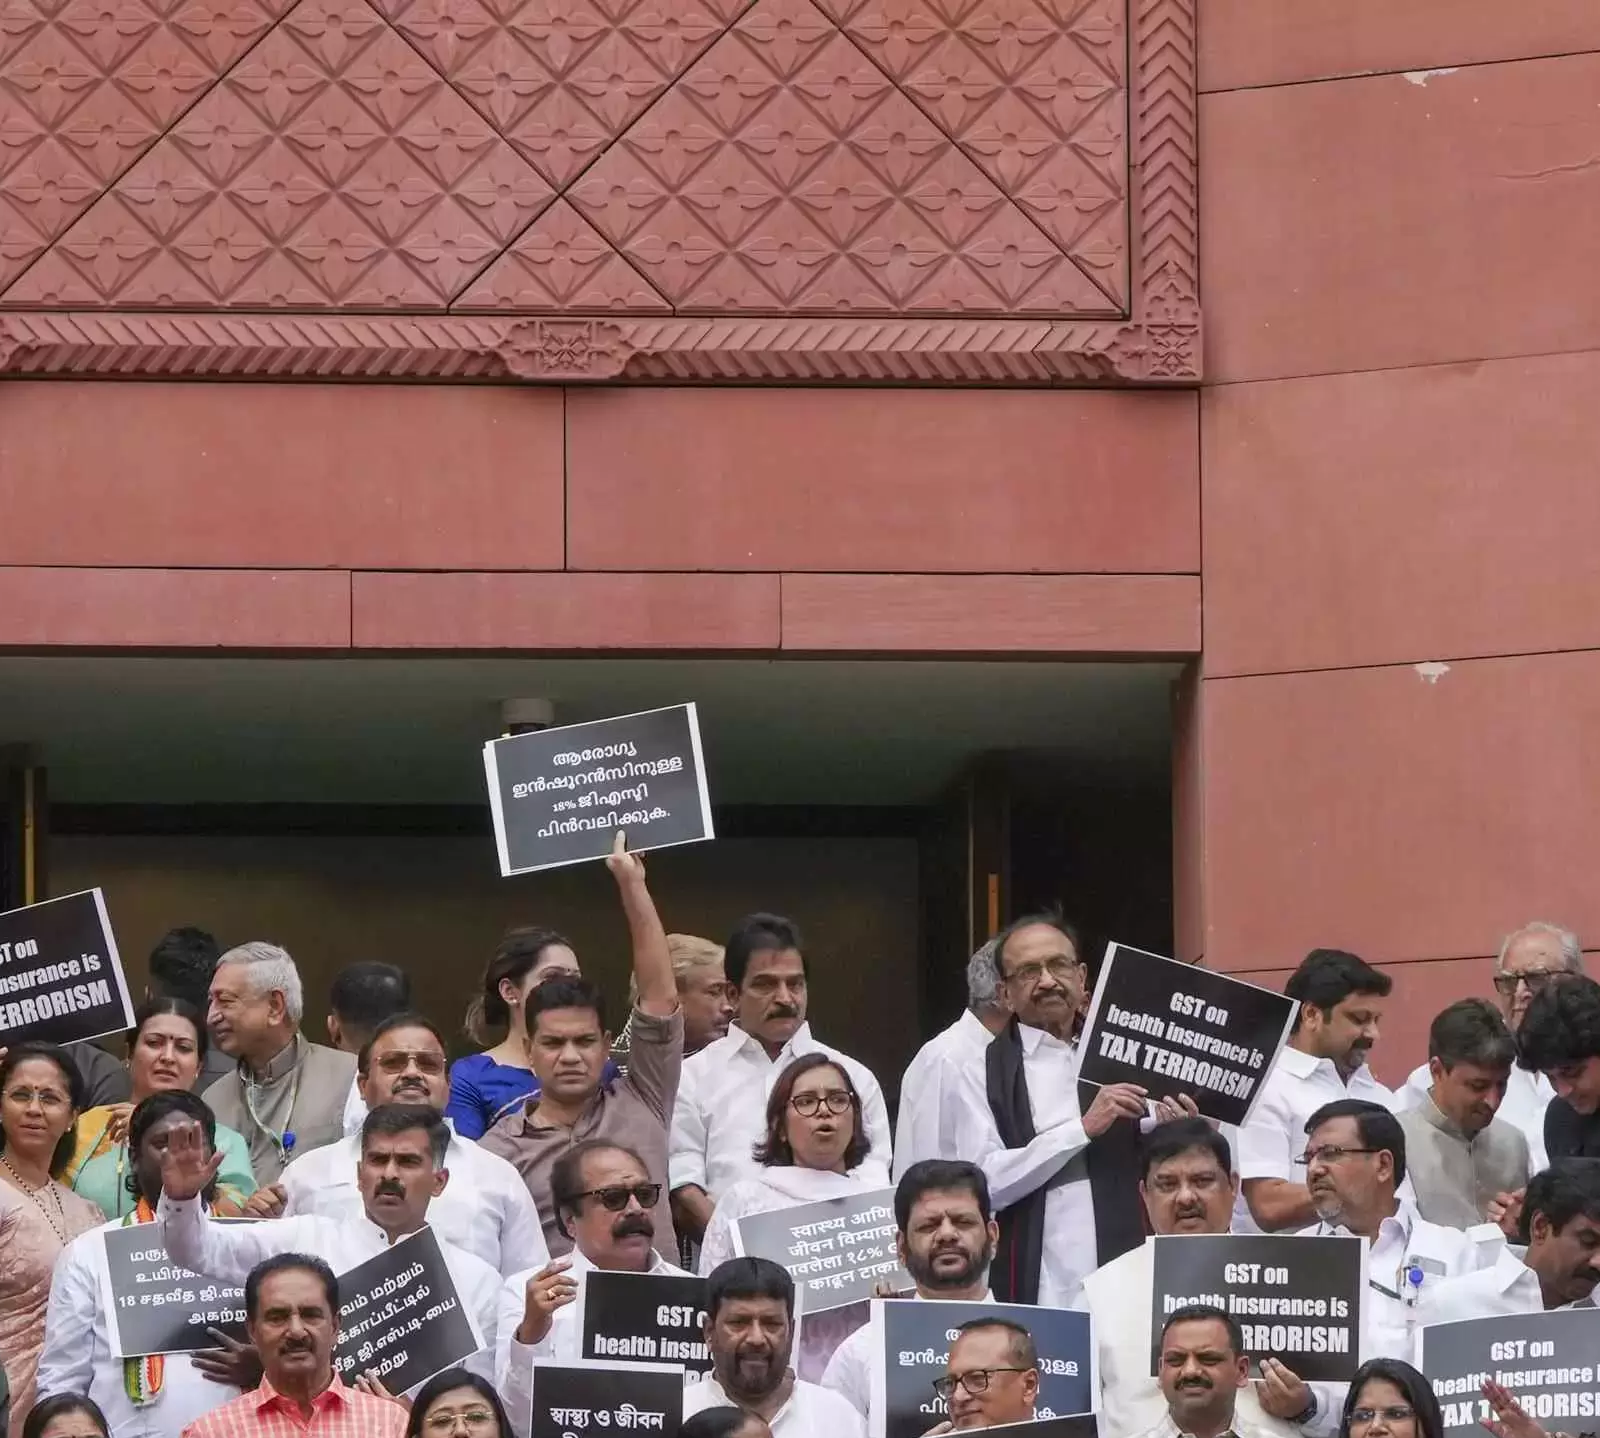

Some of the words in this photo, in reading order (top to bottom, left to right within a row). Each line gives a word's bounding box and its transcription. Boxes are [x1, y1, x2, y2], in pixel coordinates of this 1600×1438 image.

[552, 799, 577, 813] 18%
[14, 938, 40, 960] on
[81, 953, 101, 973] is
[1169, 991, 1207, 1019] GST
[1204, 1006, 1230, 1027] on
[1106, 1003, 1166, 1038] health
[1165, 1021, 1249, 1064] insurance
[1247, 1048, 1264, 1069] is
[1099, 1031, 1142, 1066] TAX
[1142, 1044, 1256, 1100] TERRORISM
[1224, 1263, 1261, 1284] GST
[1263, 1267, 1289, 1285] on
[1229, 1293, 1327, 1317] insurance
[1330, 1296, 1348, 1318] is
[1490, 1339, 1527, 1362] GST
[1529, 1340, 1555, 1358] on
[1495, 1366, 1594, 1388] insurance
[593, 1409, 611, 1427] ও
[613, 1403, 666, 1430] জীবন
